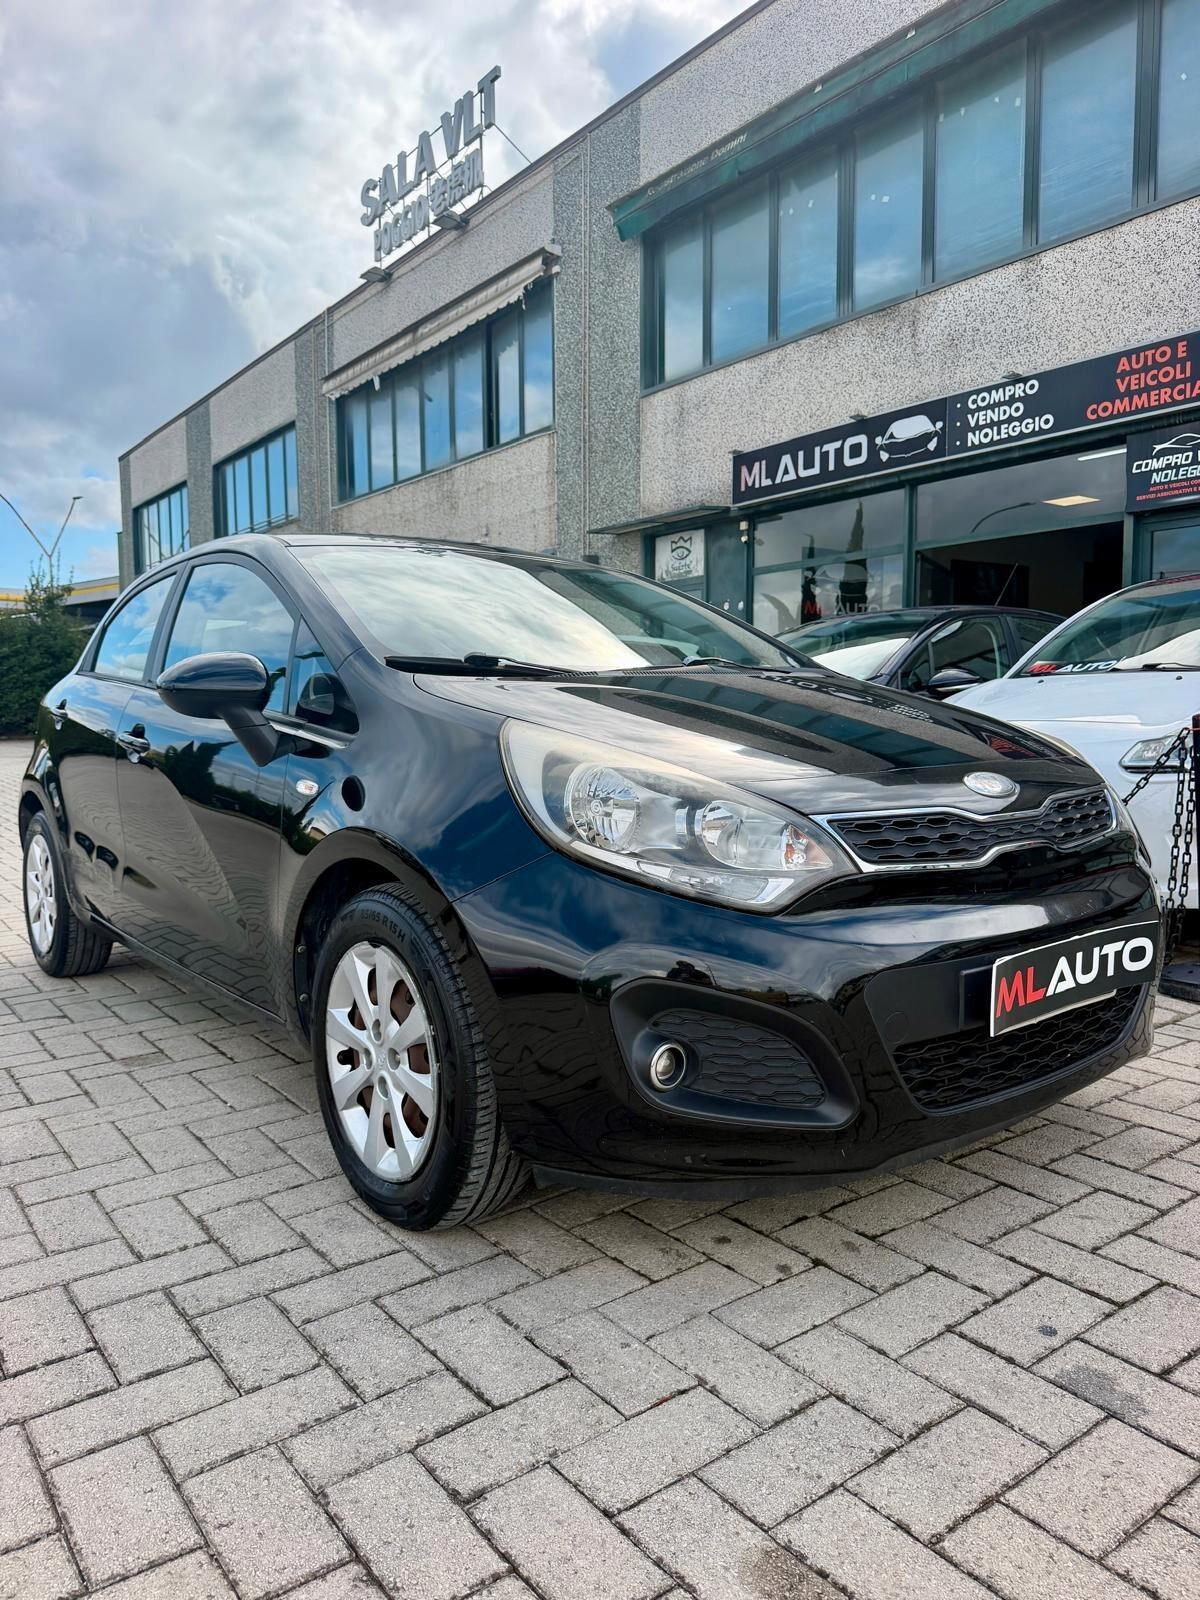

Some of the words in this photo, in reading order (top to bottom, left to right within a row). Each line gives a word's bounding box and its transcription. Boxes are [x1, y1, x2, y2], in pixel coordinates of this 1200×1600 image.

[361, 131, 436, 227] SALA
[440, 65, 501, 160] VLT
[374, 194, 430, 262] POGGIO
[1116, 345, 1172, 373] AUTO
[1177, 340, 1187, 358] E
[1116, 361, 1191, 393] VEICOLI
[967, 379, 1039, 410] COMPRO
[967, 401, 1024, 427] VENDO
[967, 413, 1054, 447] NOLEGGIO
[1132, 451, 1193, 473] COMPRO
[1149, 484, 1163, 492] AUTO
